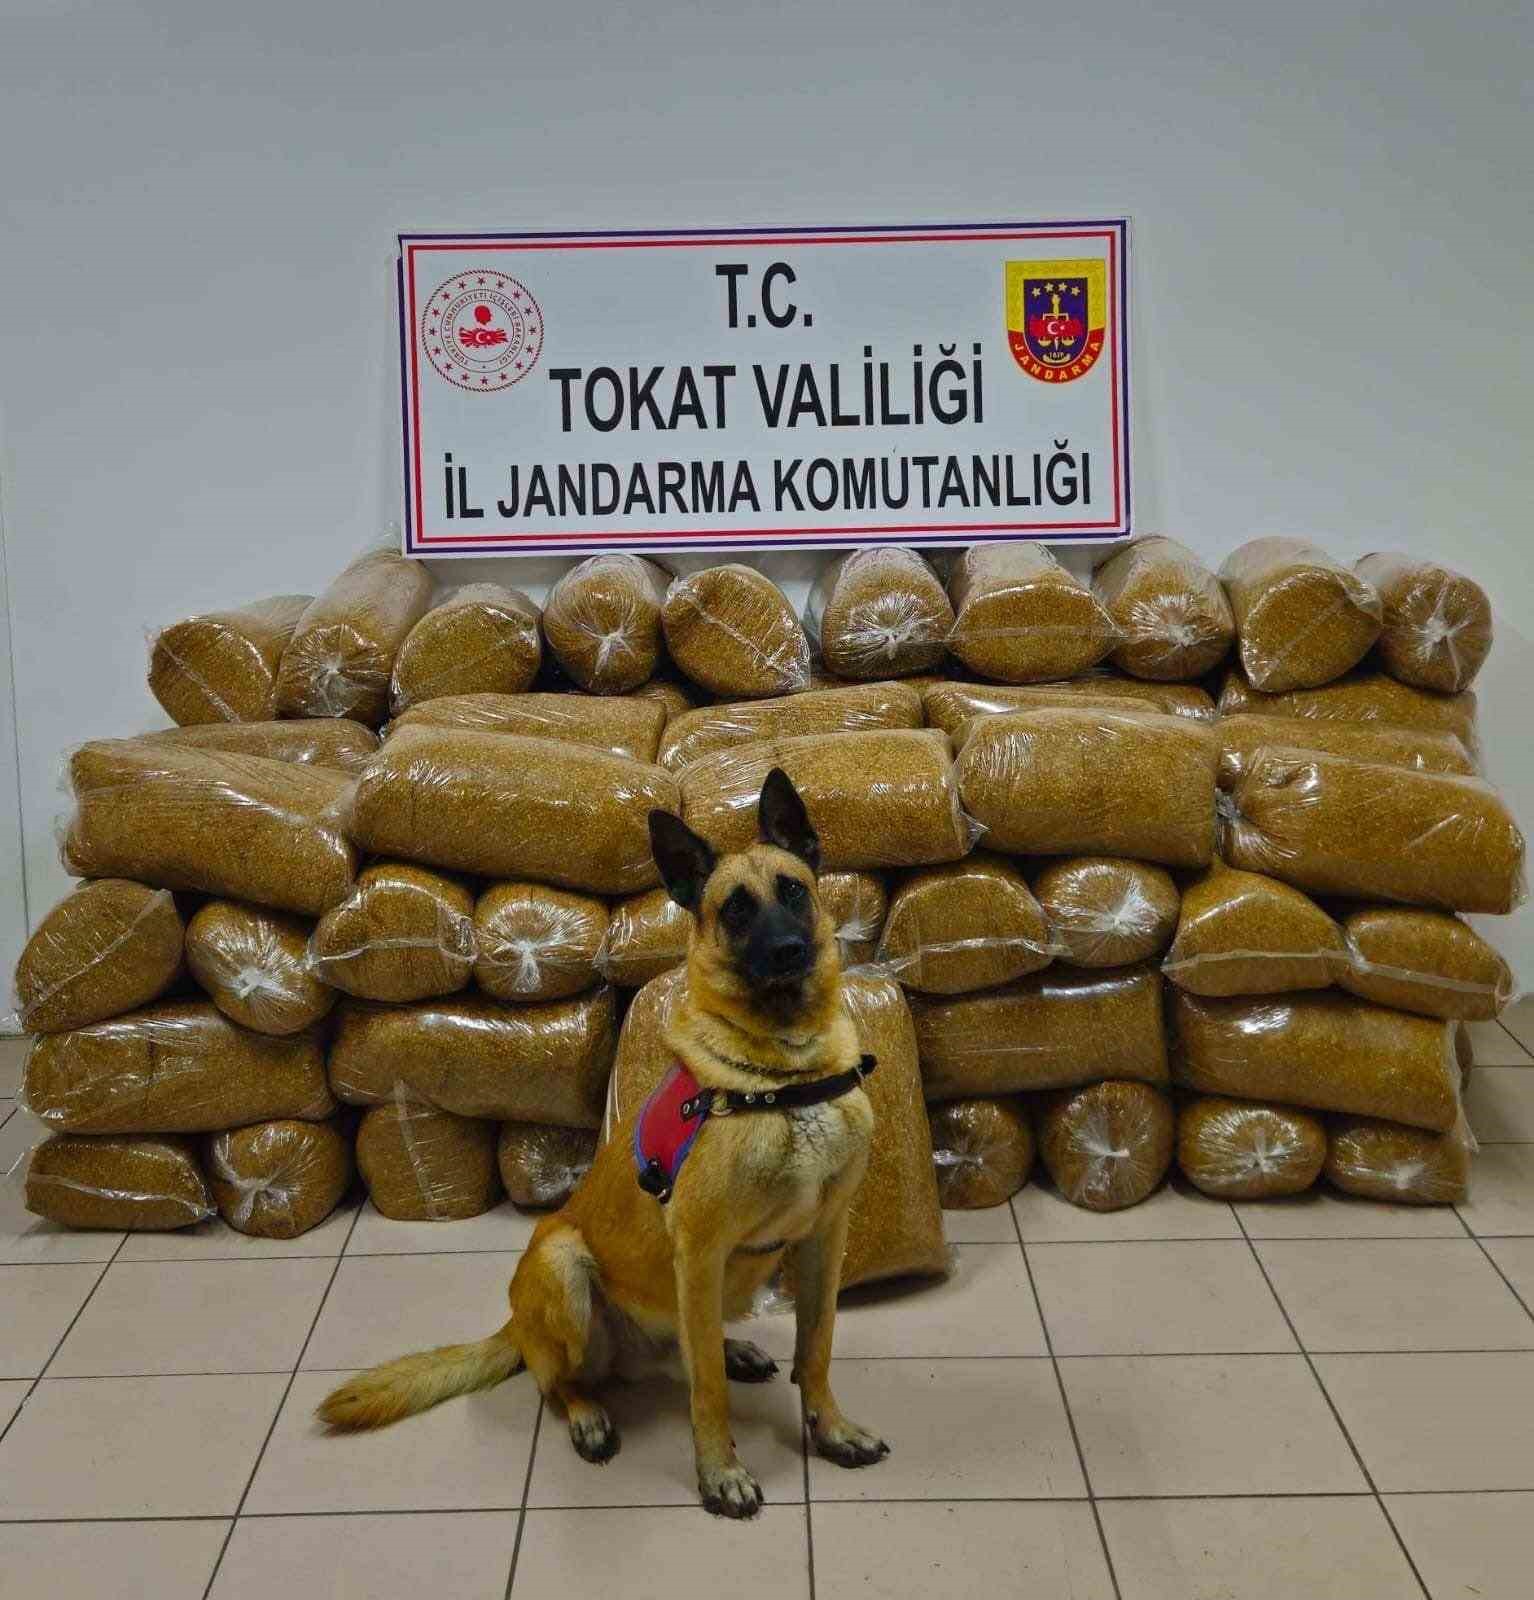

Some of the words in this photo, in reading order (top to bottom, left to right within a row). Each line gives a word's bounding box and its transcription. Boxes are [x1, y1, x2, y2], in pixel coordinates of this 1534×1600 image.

[715, 262, 813, 329] T.C.
[548, 366, 737, 433] TOKAT
[751, 342, 983, 428] VALİLİĞİ
[1014, 341, 1100, 381] JANDARMA
[444, 452, 485, 519] İL
[497, 460, 761, 518] JANDARMA
[773, 439, 1091, 512] KOMUTANLIĞI
